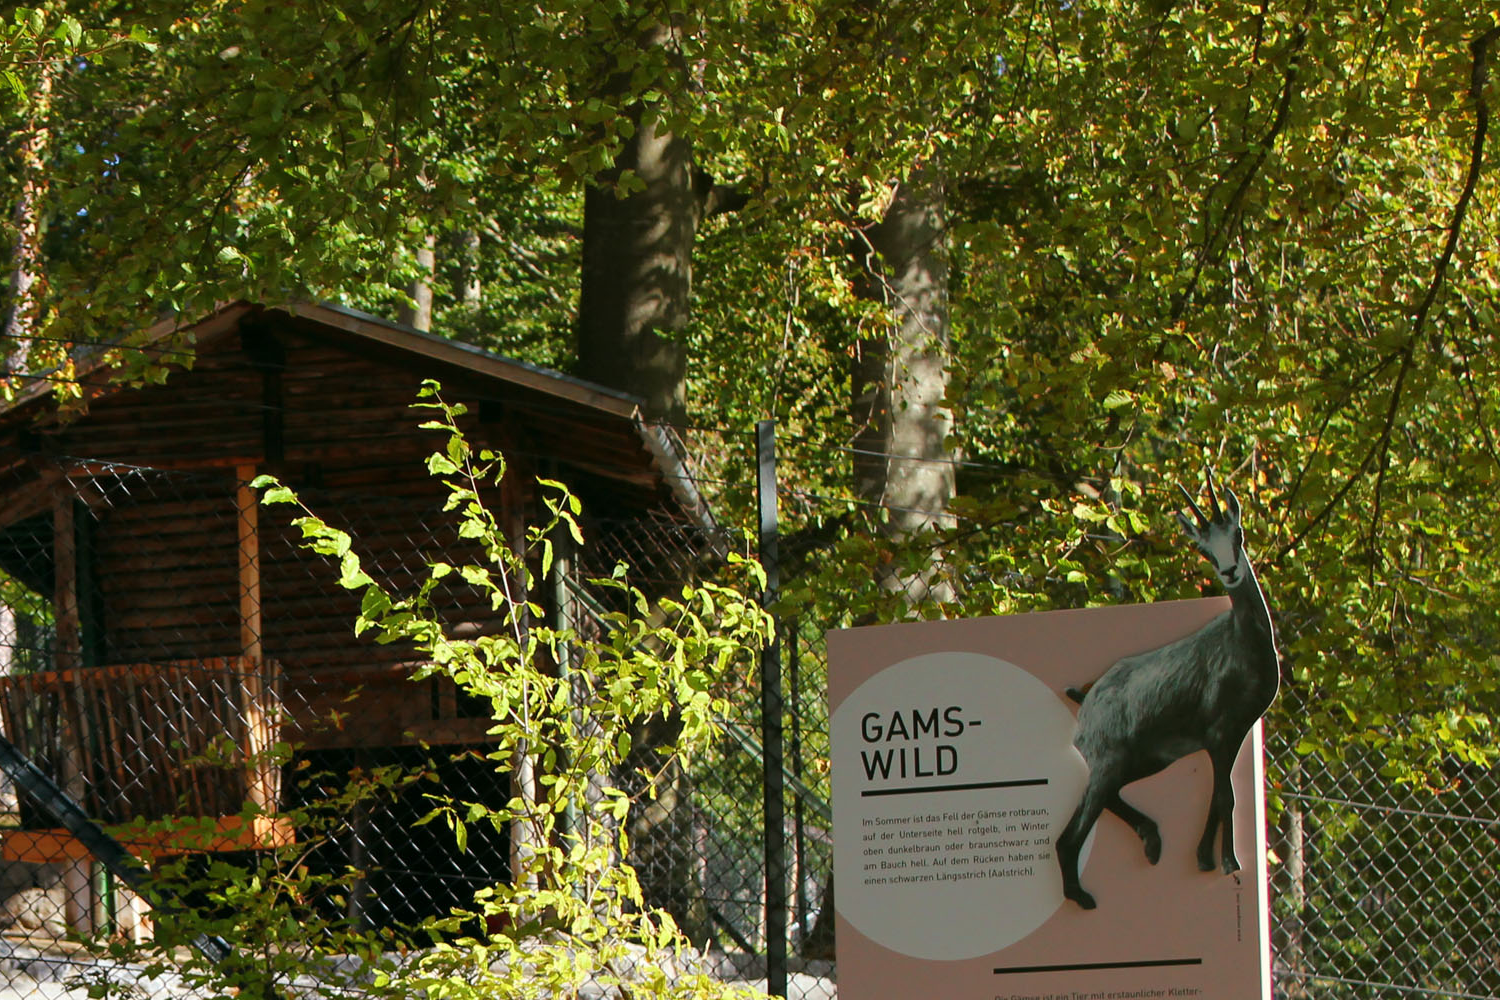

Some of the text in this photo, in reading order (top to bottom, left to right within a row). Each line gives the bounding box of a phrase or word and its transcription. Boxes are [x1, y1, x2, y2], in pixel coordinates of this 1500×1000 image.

[861, 706, 982, 743] GAMS-
[861, 745, 958, 781] WILD
[862, 808, 1049, 826] Im Sommer ist das Fell der Gämse rotbraun,
[862, 832, 875, 841] auf
[880, 832, 894, 840] der
[899, 829, 942, 838] Unterseite
[947, 827, 963, 835] hell
[967, 825, 1000, 835] rotgelb,
[1020, 822, 1049, 830] Winter
[862, 836, 1049, 855] oben dunkelbraun oder braunschwarz und
[880, 860, 906, 869] Bauch
[910, 858, 929, 867] hell.
[932, 857, 946, 865] Auf
[950, 857, 969, 865] dem
[973, 855, 1004, 863] Rücken
[1008, 853, 1034, 861] haben
[1038, 851, 1050, 860] sie
[888, 875, 934, 883] schwarzen
[936, 870, 986, 881] Längsstrich
[988, 867, 1034, 877] (Aalstrich).
[1055, 993, 1068, 1000] ein
[1071, 992, 1088, 1000] Tier
[1107, 989, 1165, 999] erstaunlicher
[1167, 988, 1202, 996] Kletter-
